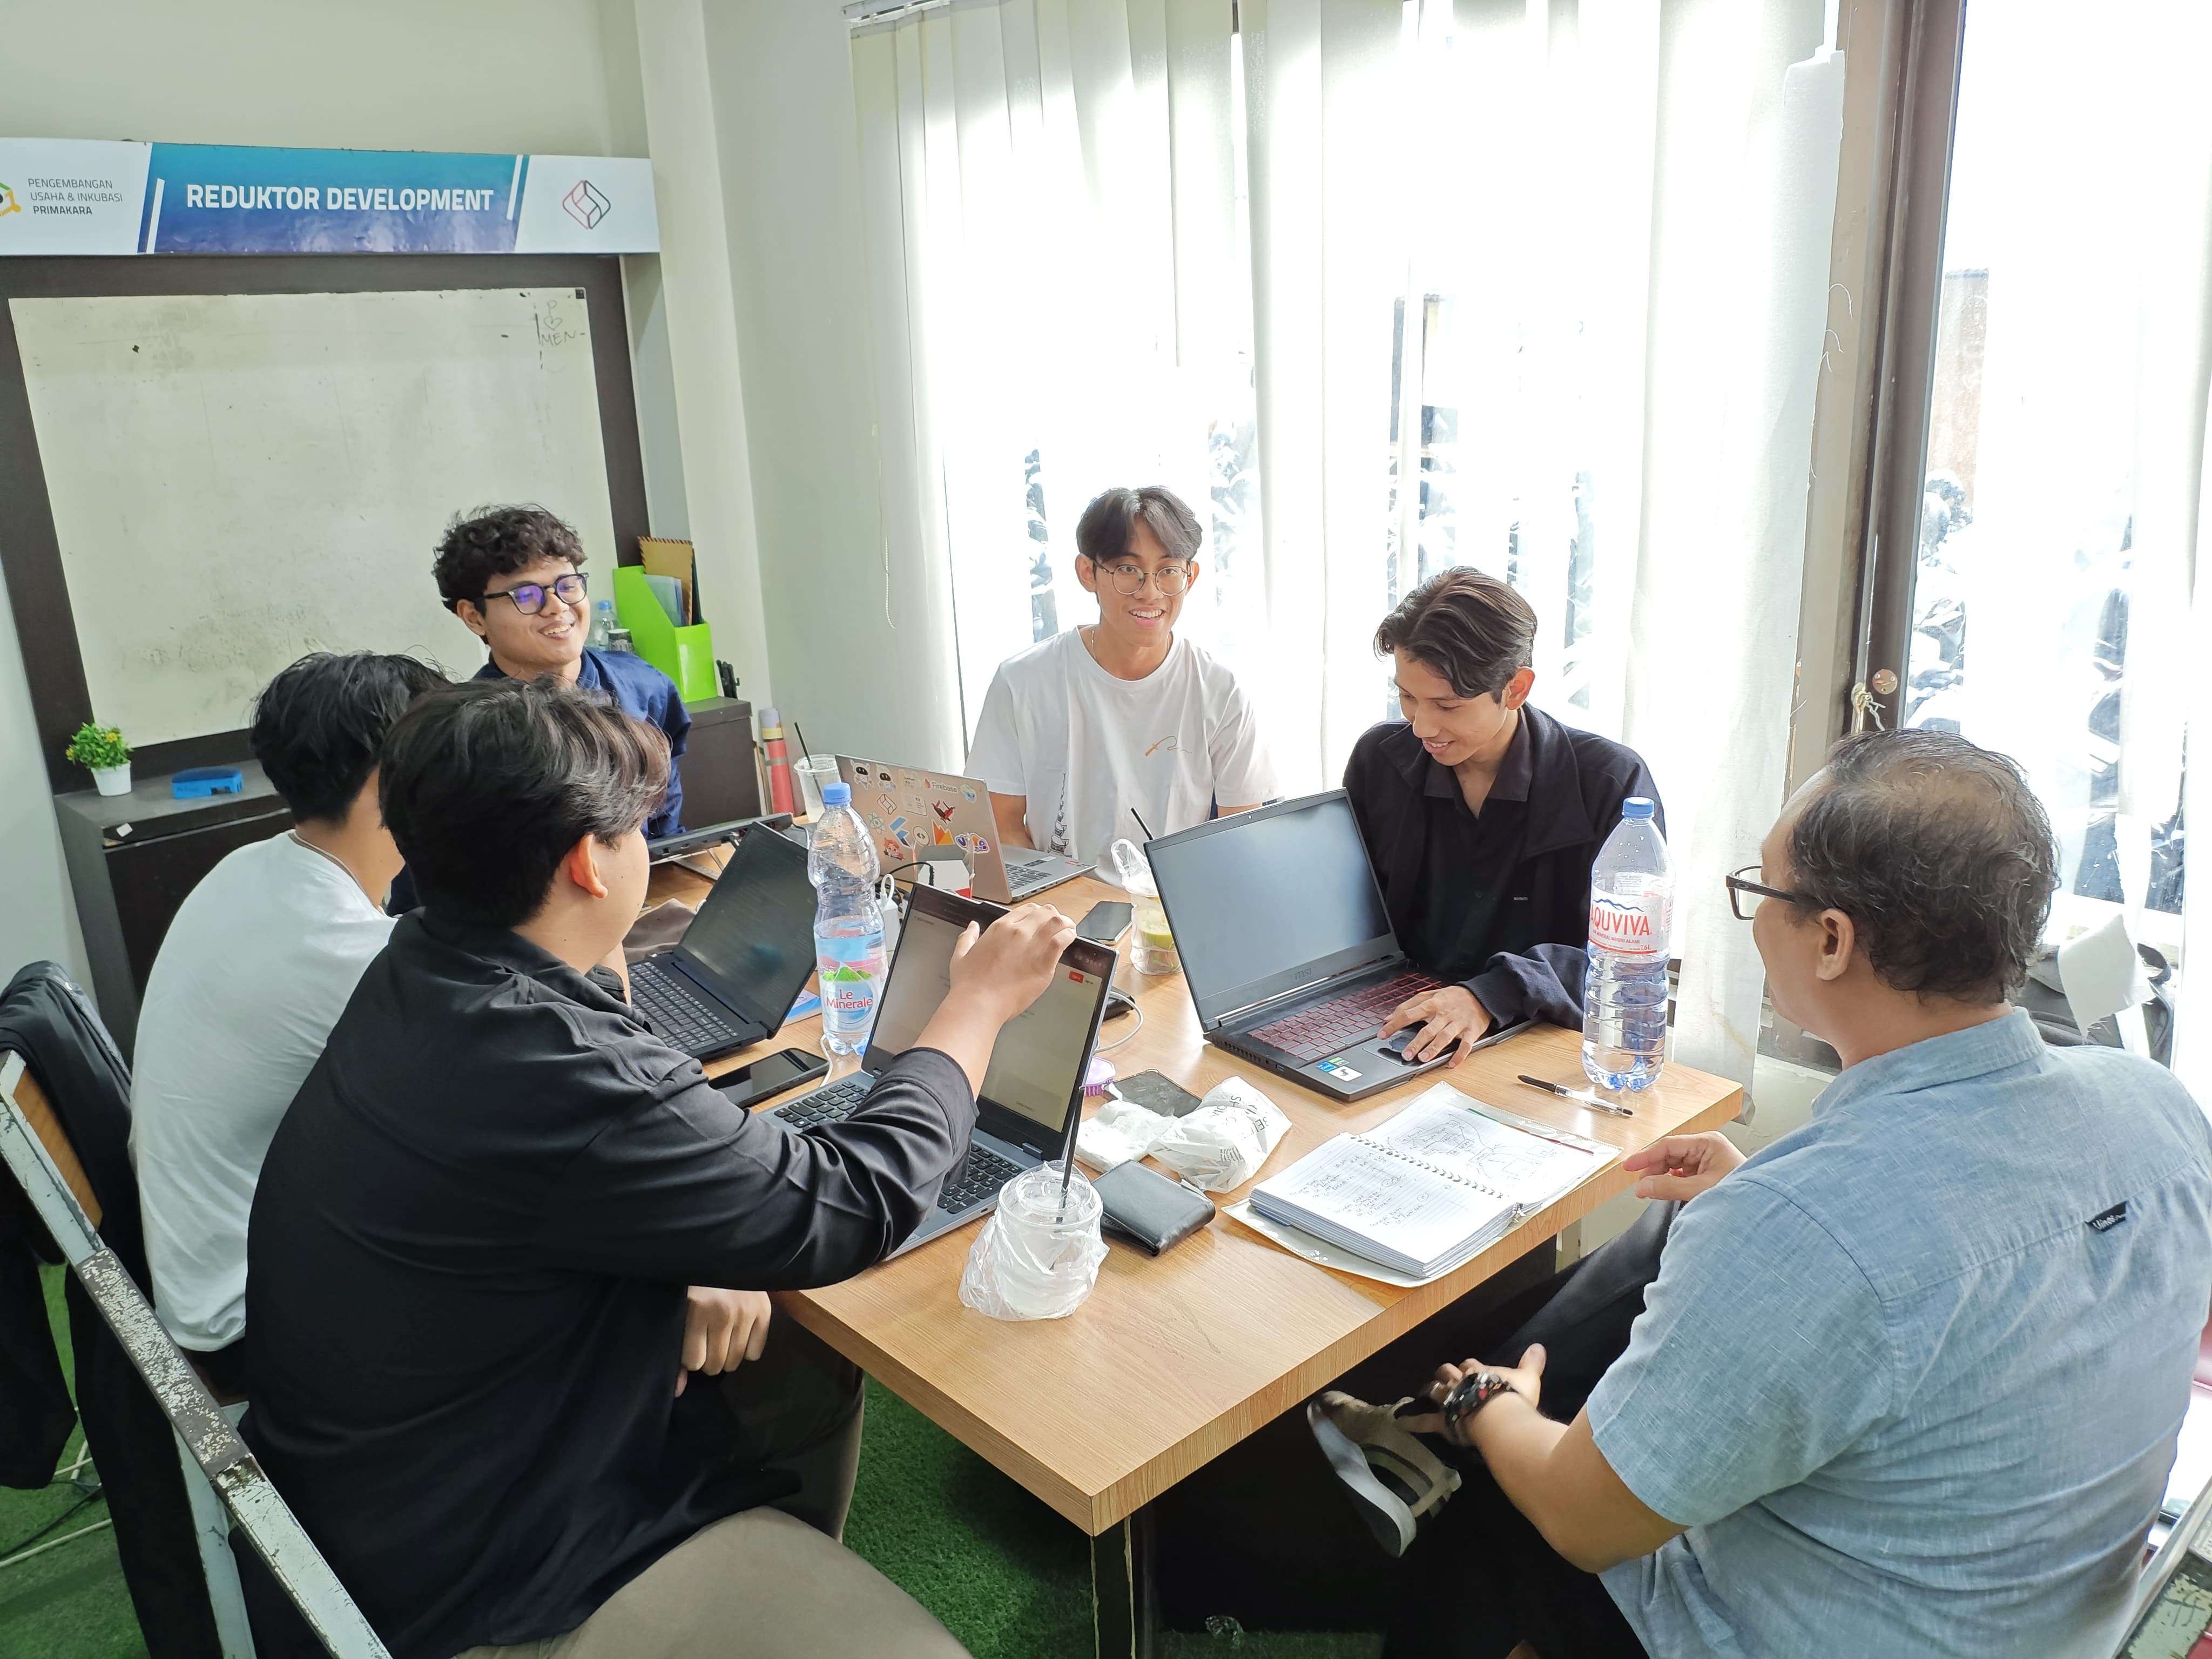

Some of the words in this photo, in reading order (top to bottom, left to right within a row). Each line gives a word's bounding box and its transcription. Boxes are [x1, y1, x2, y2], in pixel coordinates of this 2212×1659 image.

[28, 178, 113, 189] PENGEMBANGAN
[30, 191, 65, 201] USAHA
[67, 192, 75, 201] &
[77, 192, 123, 203] INKUBASI
[187, 184, 320, 210] REDUKTOR
[326, 187, 494, 211] DEVELOPMENT
[33, 205, 93, 215] PRIMAKARA
[932, 781, 957, 793] Firebase
[1590, 904, 1650, 936] AQUVIVA
[838, 988, 854, 1000] Le
[826, 996, 873, 1009] Minerale
